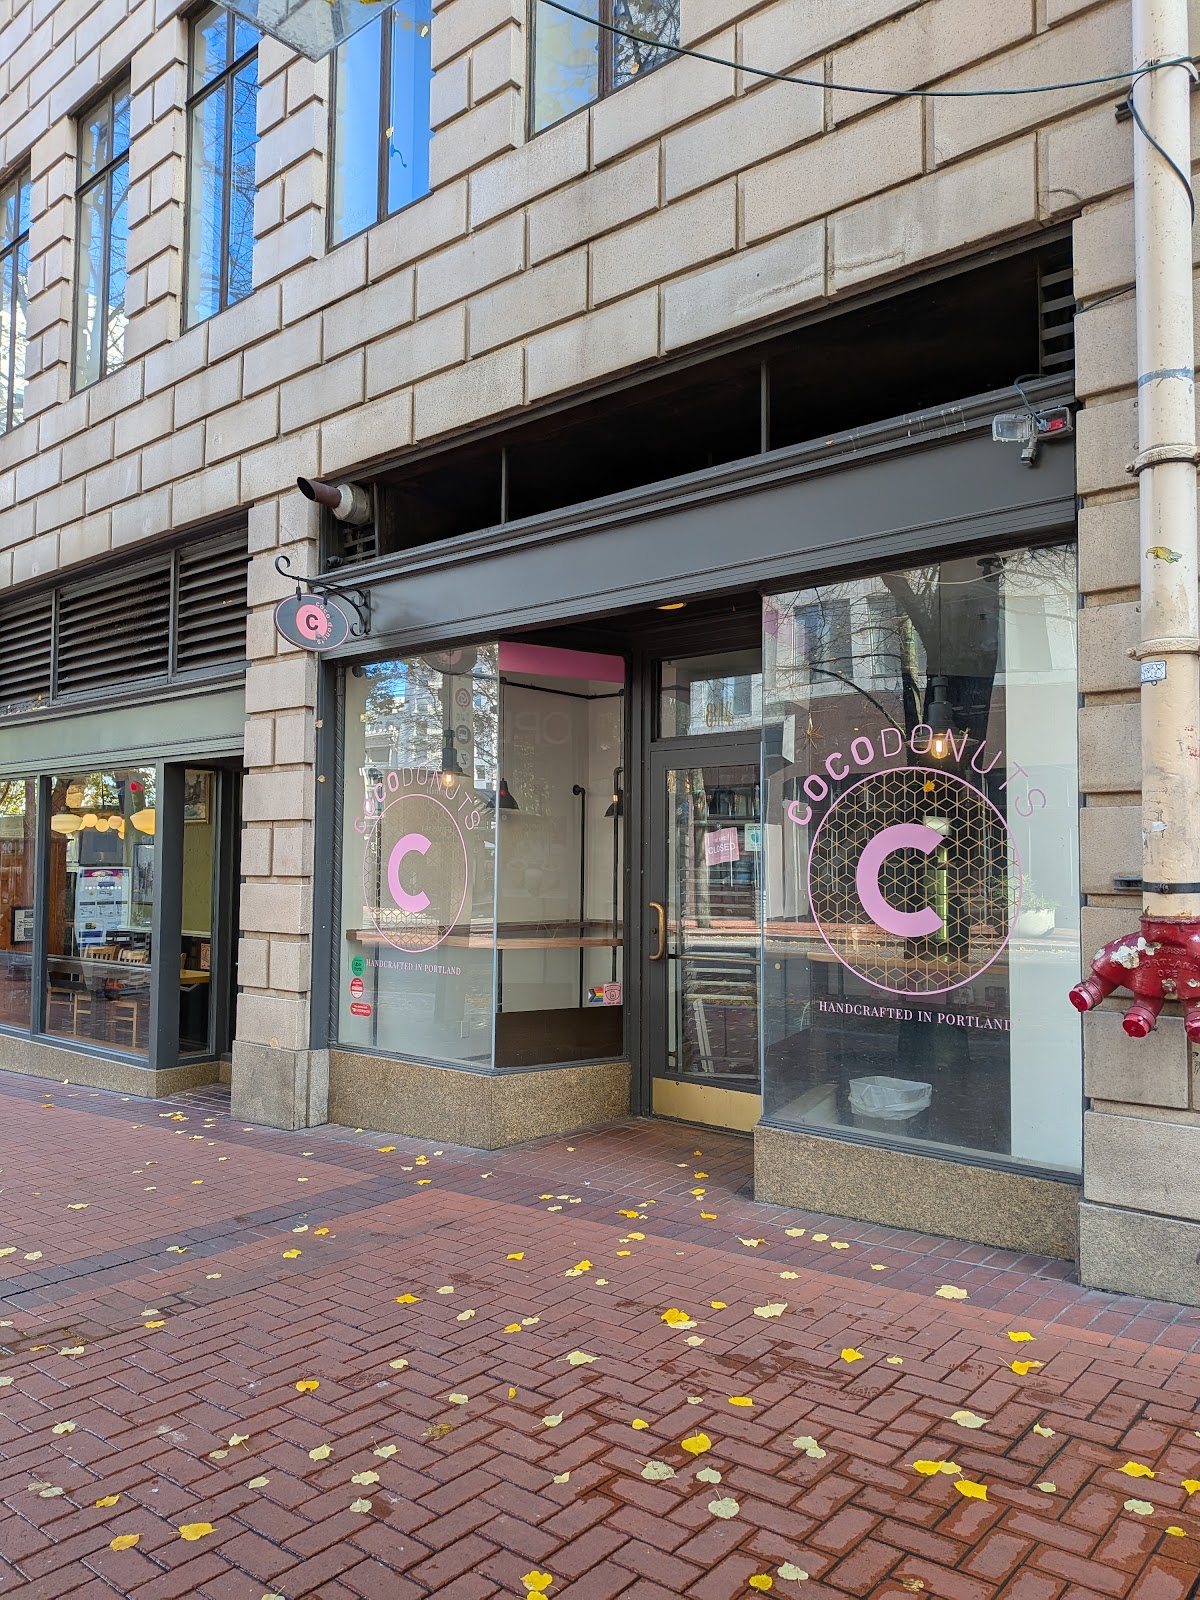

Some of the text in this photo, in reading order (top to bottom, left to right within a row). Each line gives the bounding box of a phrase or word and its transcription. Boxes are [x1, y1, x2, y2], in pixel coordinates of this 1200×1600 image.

[305, 613, 319, 631] C
[705, 701, 734, 728] 814
[707, 842, 736, 855] CLOSED
[387, 832, 432, 913] C
[856, 823, 946, 938] C
[366, 958, 413, 971] HANDCRAFTED
[415, 963, 423, 972] IN
[424, 964, 461, 976] PORTLAND
[818, 1000, 1014, 1031] HANDCRAFTED IN PORTLAND
